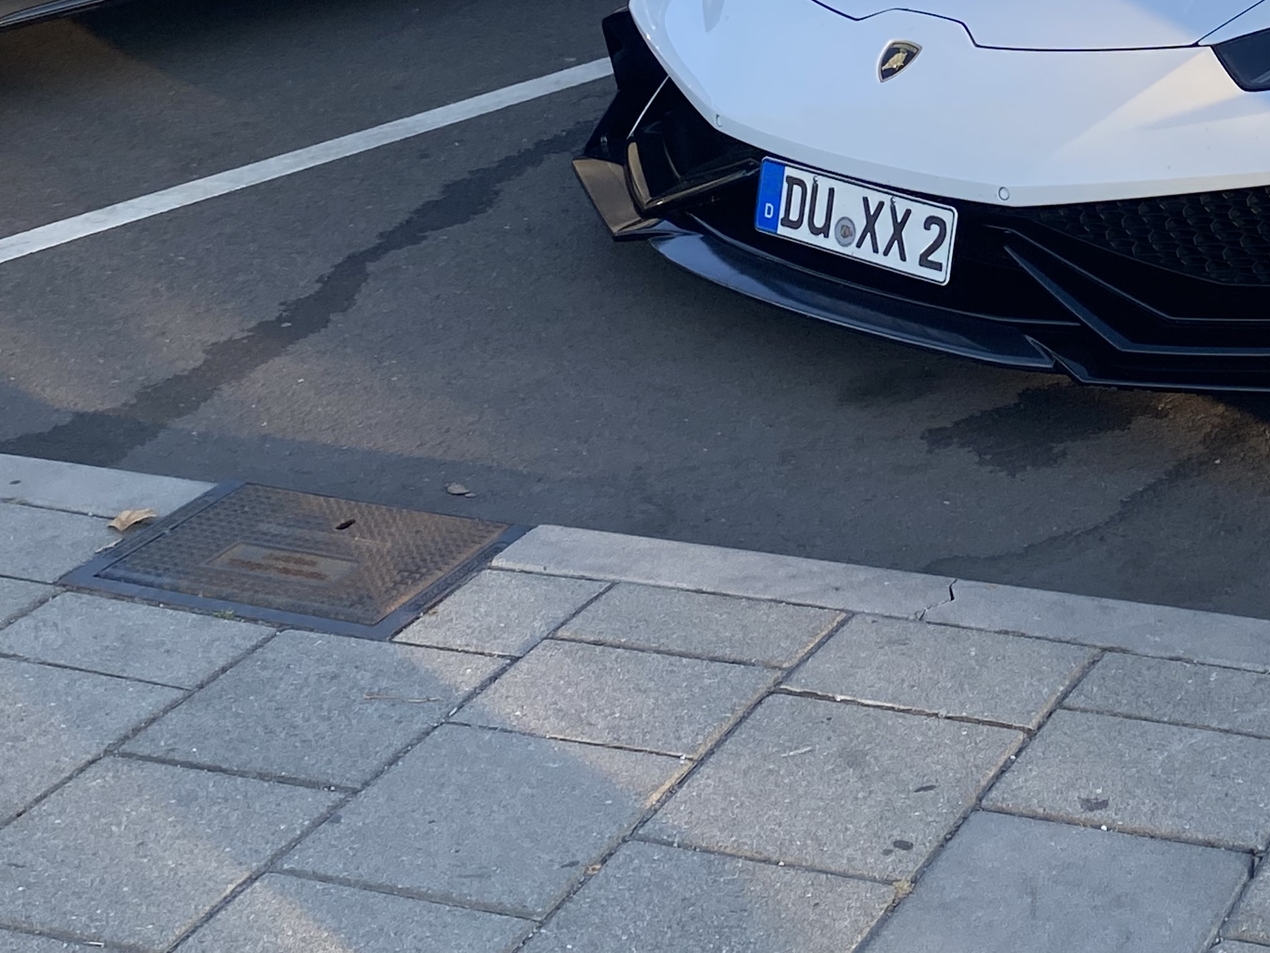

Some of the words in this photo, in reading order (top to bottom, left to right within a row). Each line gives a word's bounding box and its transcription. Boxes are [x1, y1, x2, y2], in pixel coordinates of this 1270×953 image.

[764, 203, 774, 219] D
[780, 175, 835, 238] DU
[856, 196, 912, 262] XX
[918, 214, 948, 272] 2
